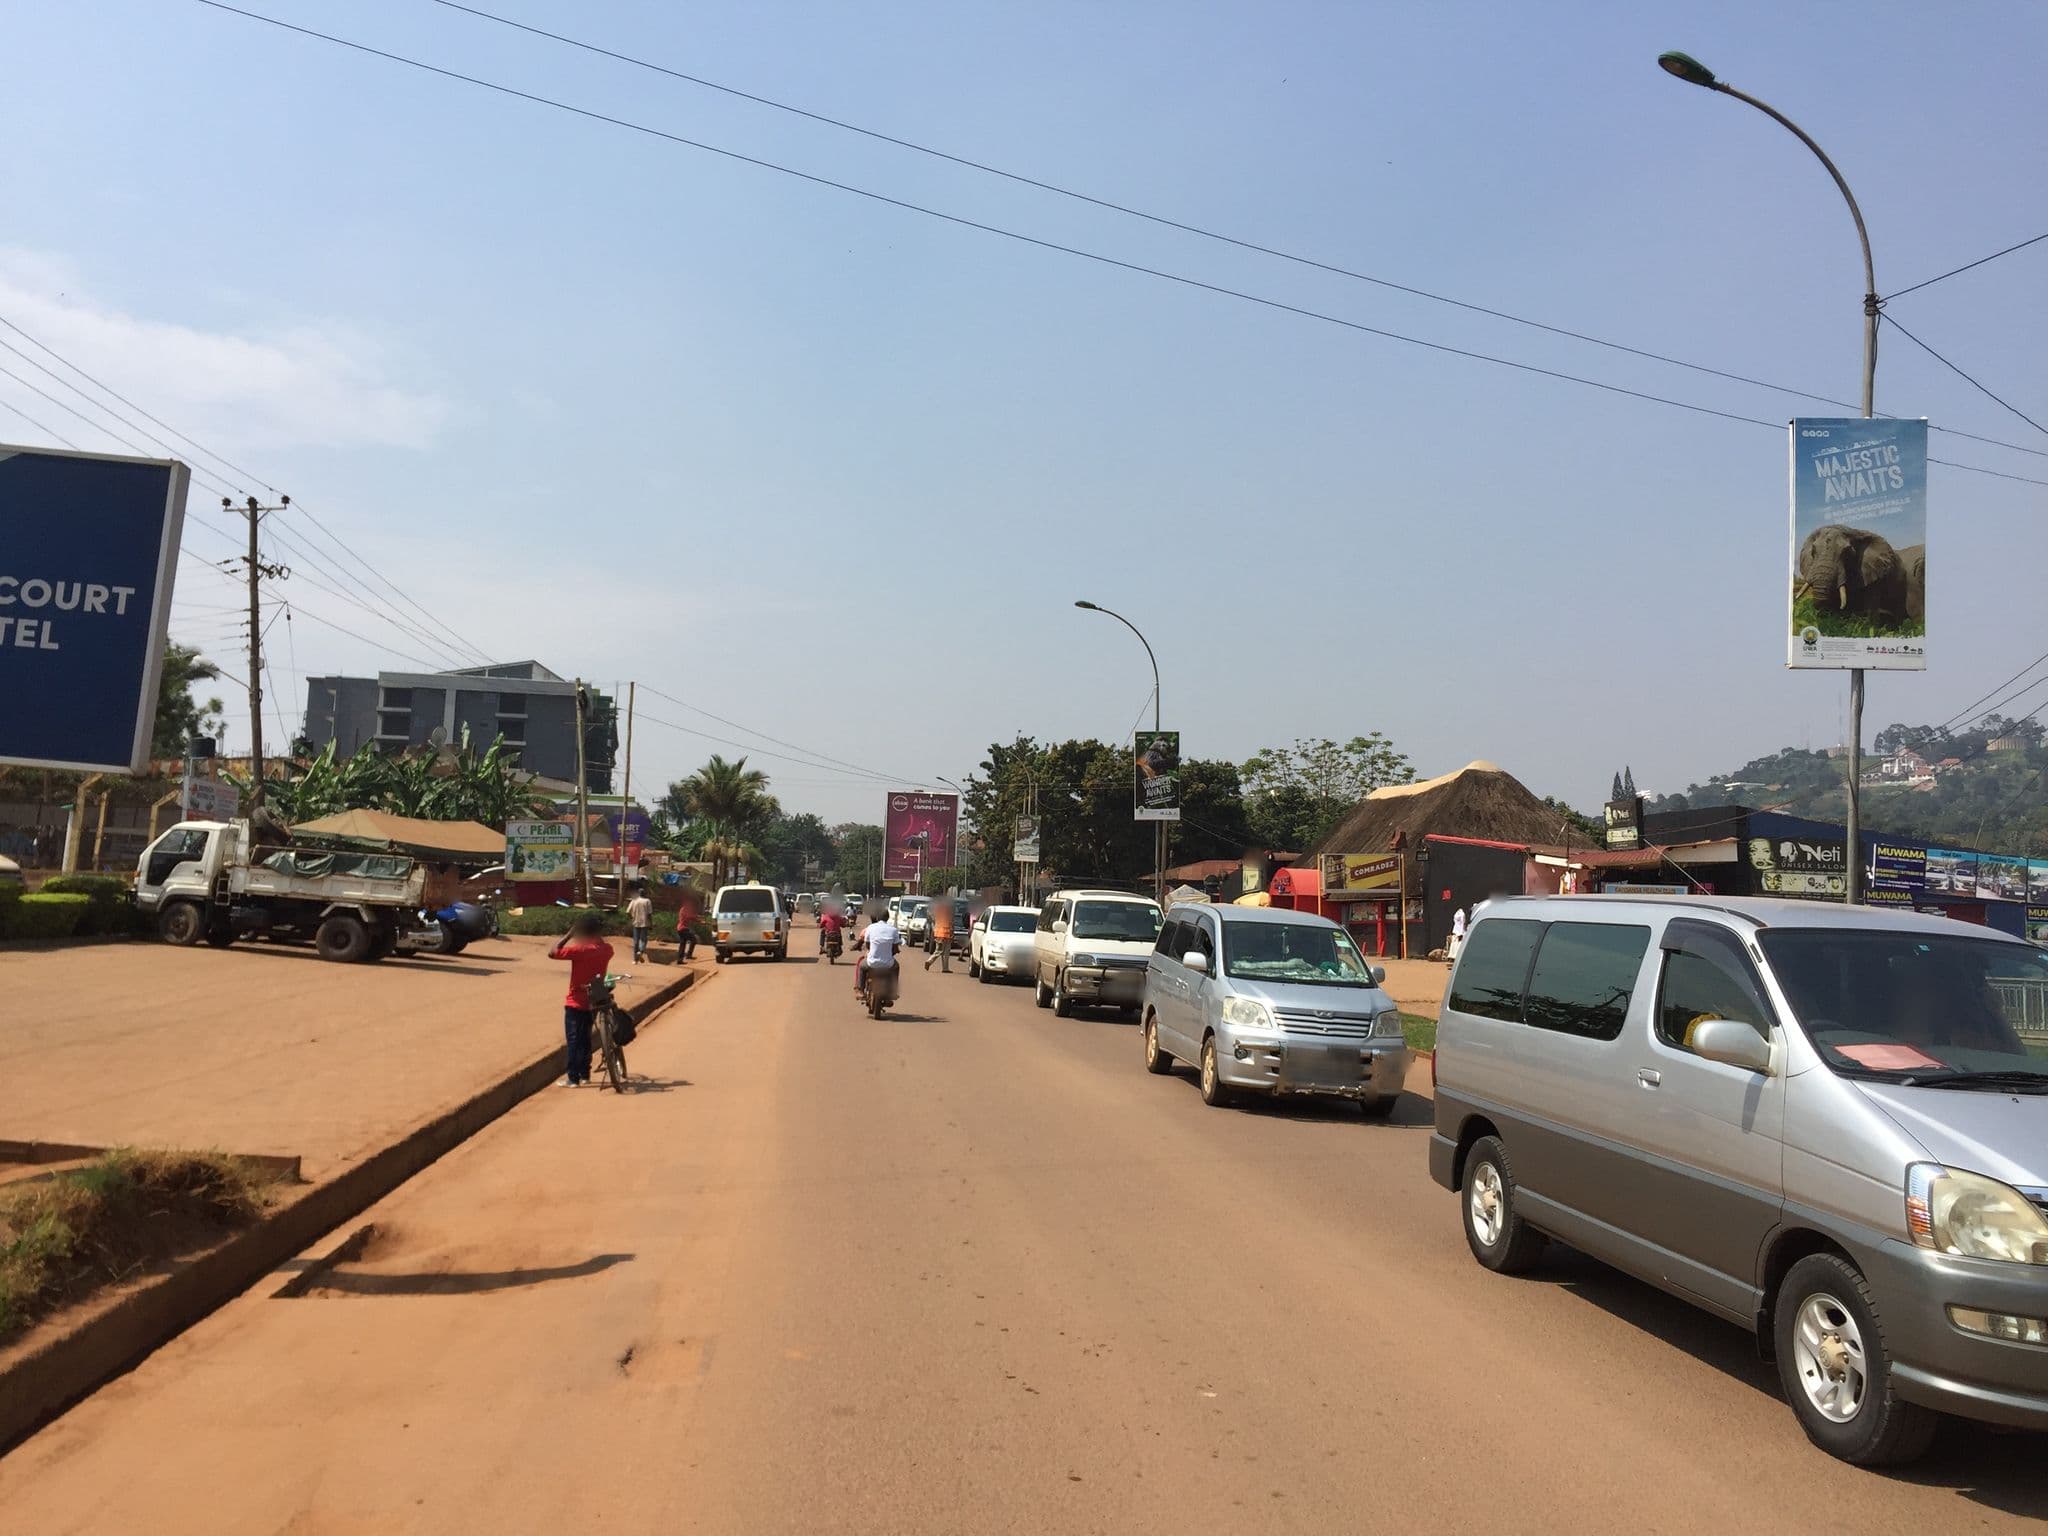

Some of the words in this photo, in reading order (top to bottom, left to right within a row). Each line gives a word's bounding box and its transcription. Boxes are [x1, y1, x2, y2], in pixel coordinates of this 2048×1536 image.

[1814, 445, 1900, 478] MAJESTIC
[1824, 465, 1905, 503] AWAITS
[0, 576, 136, 615] COURT
[530, 824, 562, 835] PEARL
[1799, 843, 1841, 861] Neti
[1877, 847, 1926, 859] MUWAMA
[1866, 891, 1913, 900] MUWAMA
